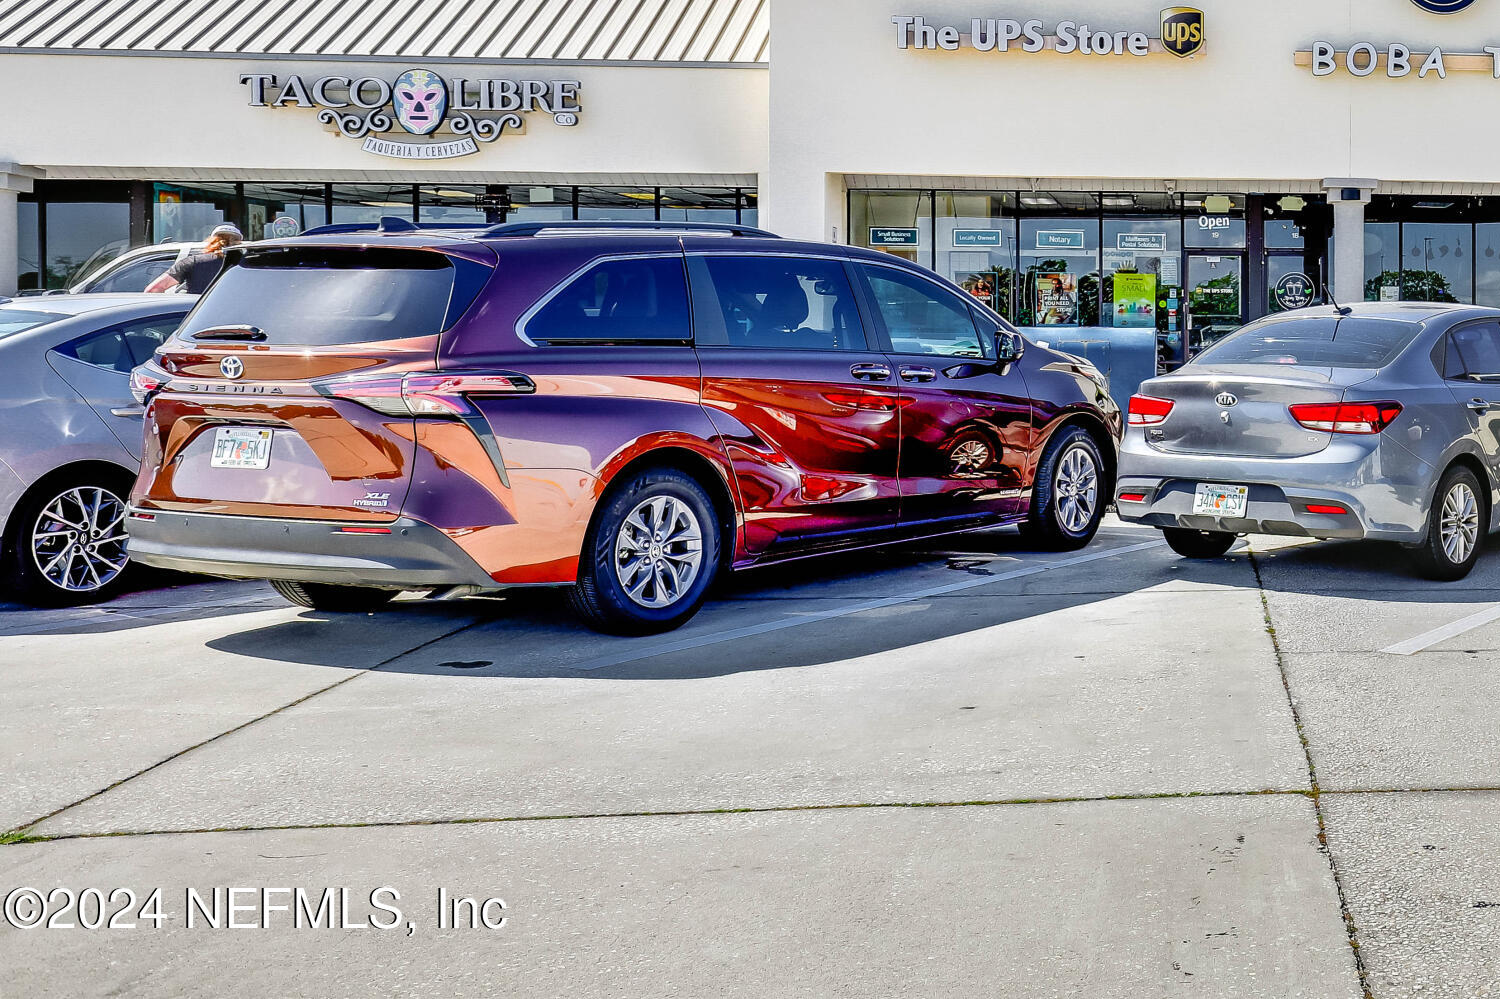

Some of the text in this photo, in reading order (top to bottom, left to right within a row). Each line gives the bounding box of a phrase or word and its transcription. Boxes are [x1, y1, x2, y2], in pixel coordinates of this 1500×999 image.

[892, 15, 1149, 56] The UPS Store
[1163, 21, 1201, 50] ups
[1311, 40, 1447, 79] BOBA
[240, 73, 583, 113] TACO LIBRE
[366, 138, 473, 157] TAQUERIA Y CERVEZAS
[1198, 215, 1230, 230] Open
[959, 234, 976, 242] Locally
[1048, 235, 1072, 244] Notary
[1211, 231, 1220, 239] 19
[189, 384, 284, 395] SIENNA
[1217, 395, 1233, 405] KIA
[364, 492, 391, 500] XLE
[1197, 492, 1244, 510] 34A CSV
[353, 499, 383, 507] HYBRID
